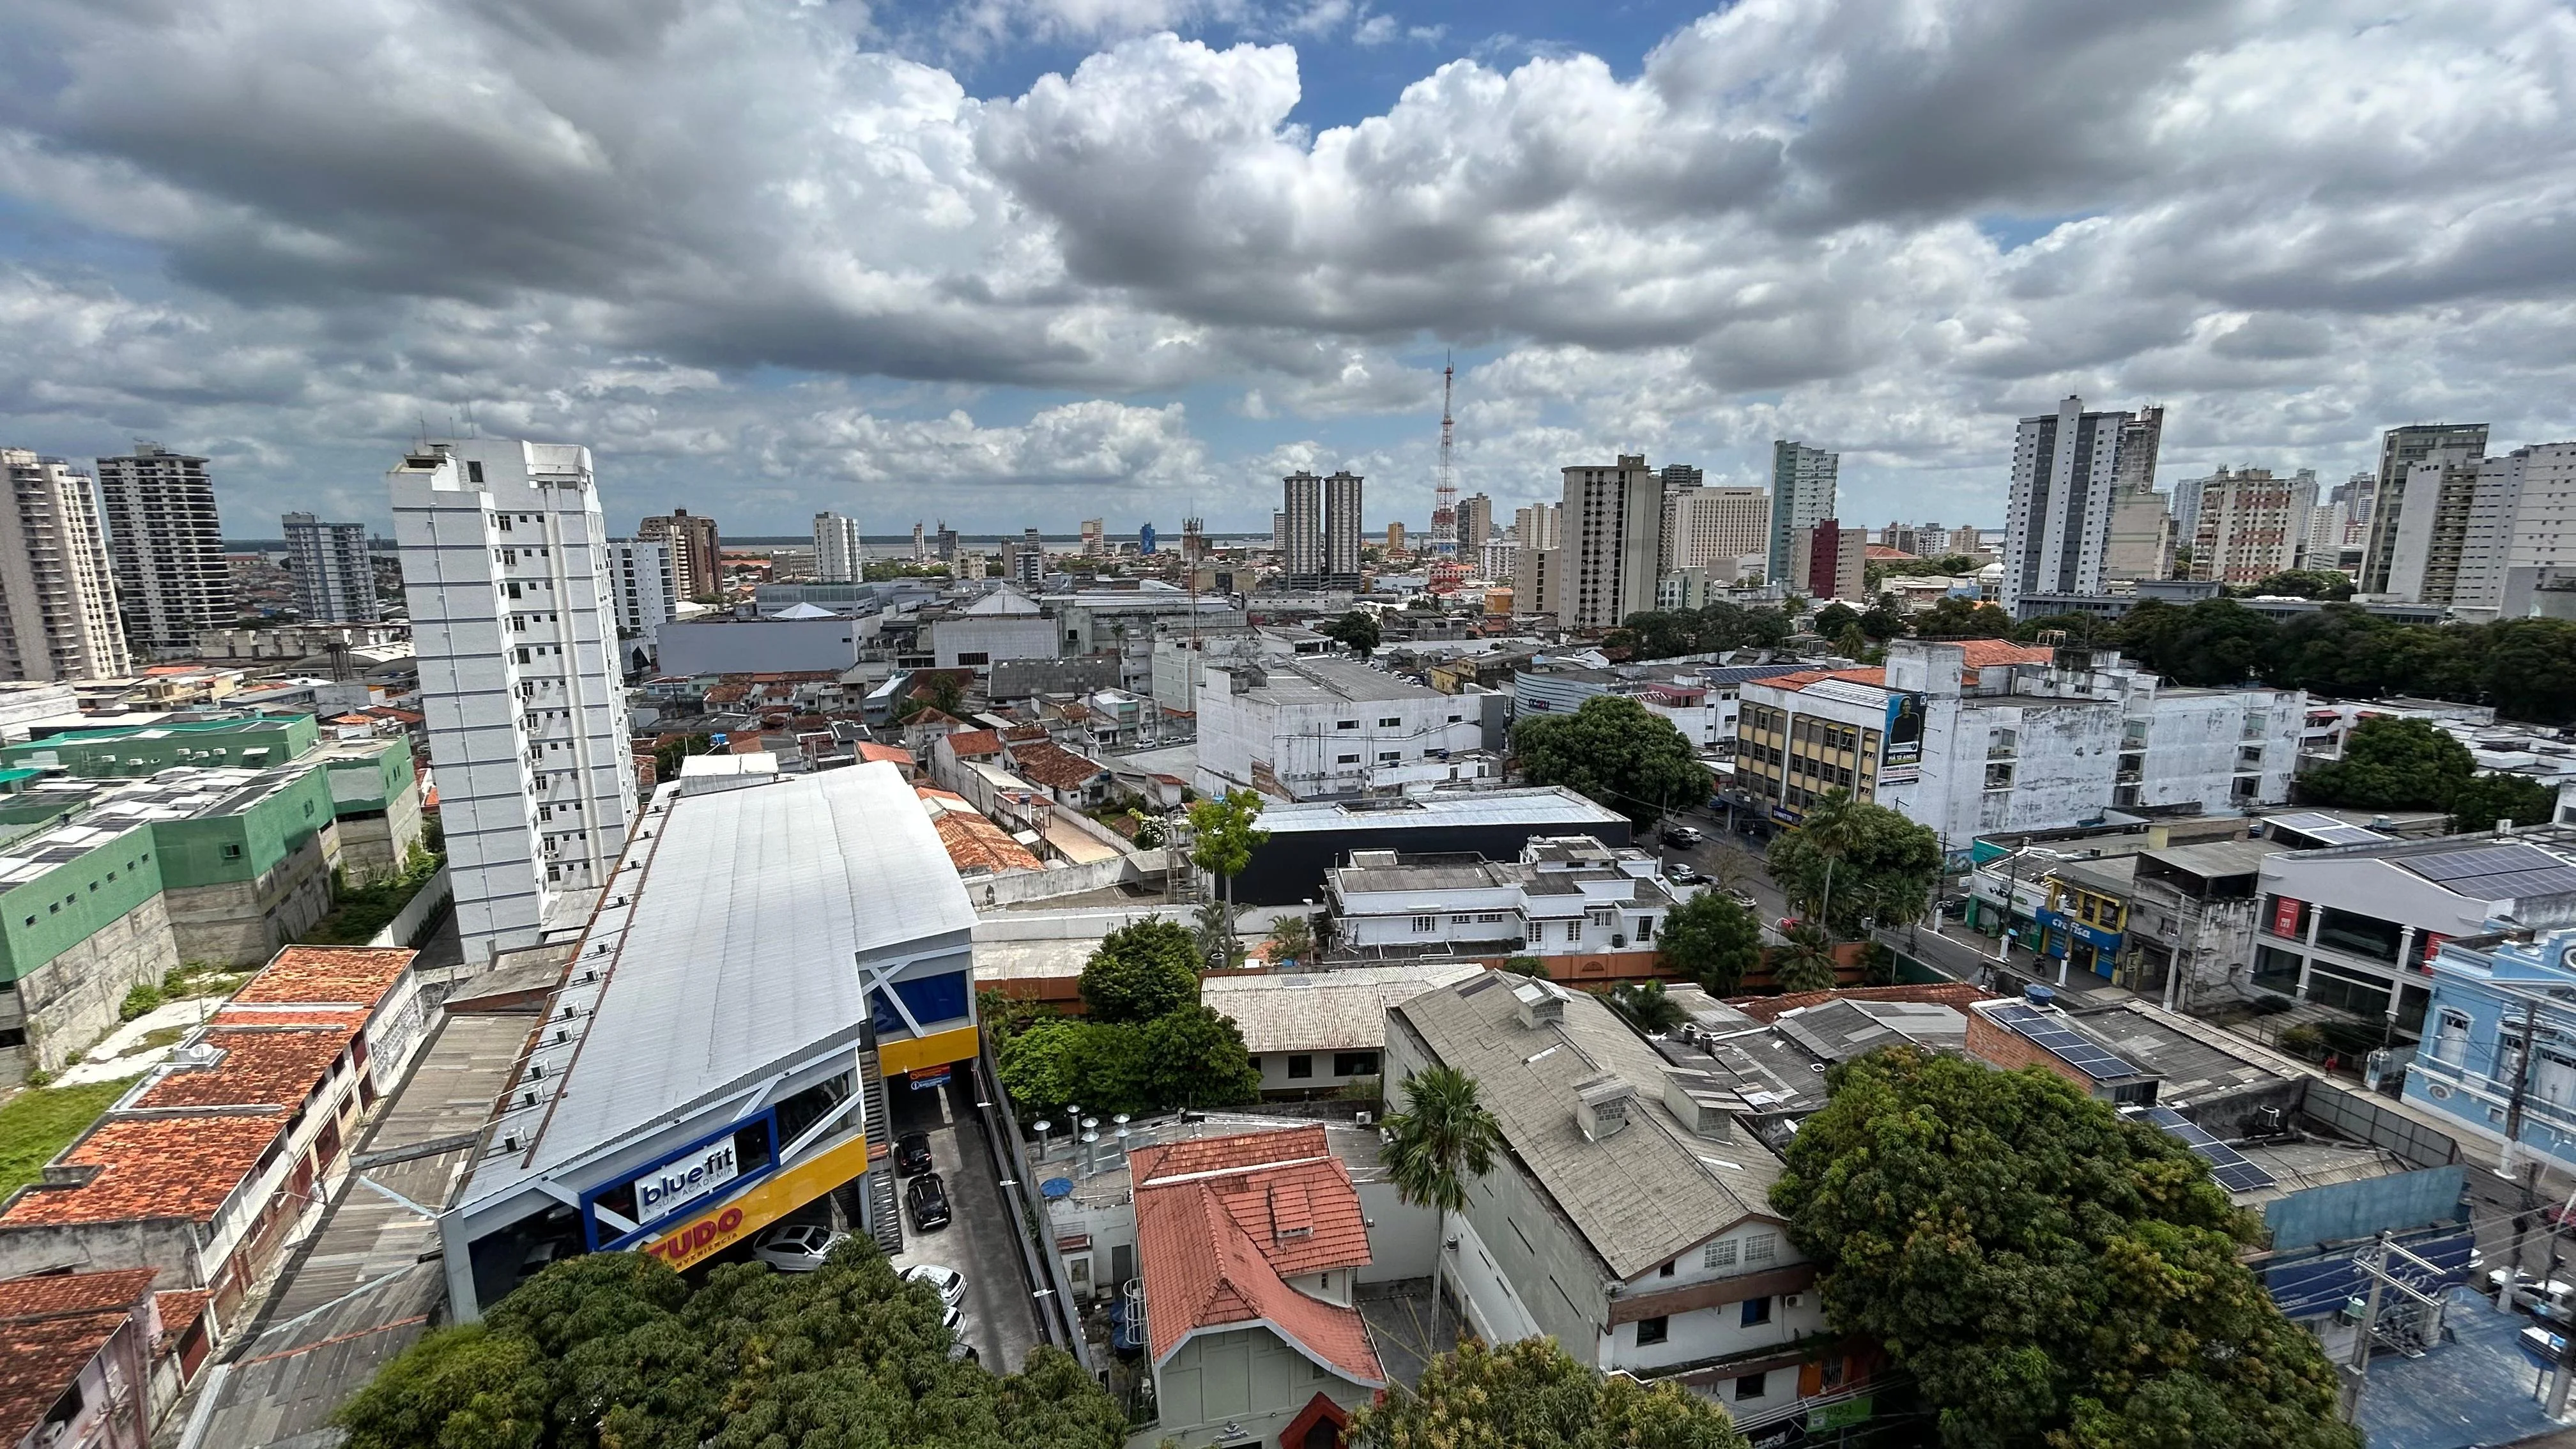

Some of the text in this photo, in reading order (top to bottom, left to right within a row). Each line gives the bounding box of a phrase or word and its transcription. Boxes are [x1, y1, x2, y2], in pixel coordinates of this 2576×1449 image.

[643, 1146, 733, 1206] bluefit
[656, 1193, 676, 1209] SUA
[682, 1167, 733, 1196] ACADEMIA
